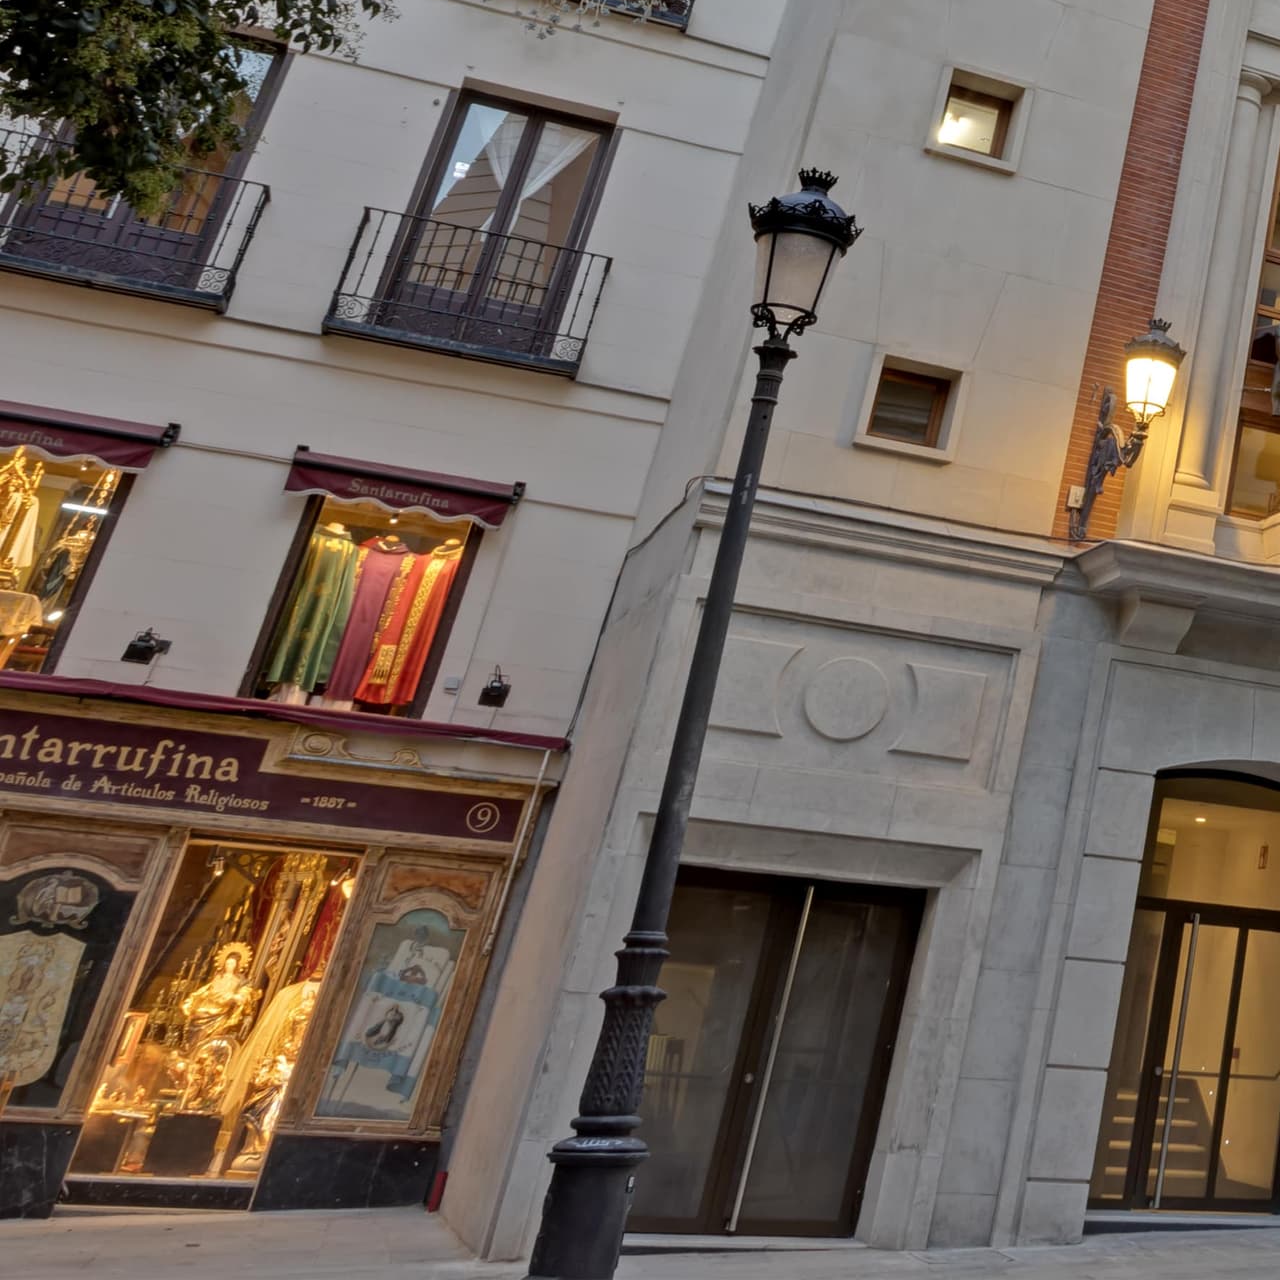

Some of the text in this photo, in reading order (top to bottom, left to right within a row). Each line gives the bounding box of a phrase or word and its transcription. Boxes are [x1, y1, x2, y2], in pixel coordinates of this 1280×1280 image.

[348, 477, 449, 509] Santarrufina
[61, 774, 82, 792] de
[185, 784, 269, 812] Religiosos
[475, 807, 493, 829] 9
